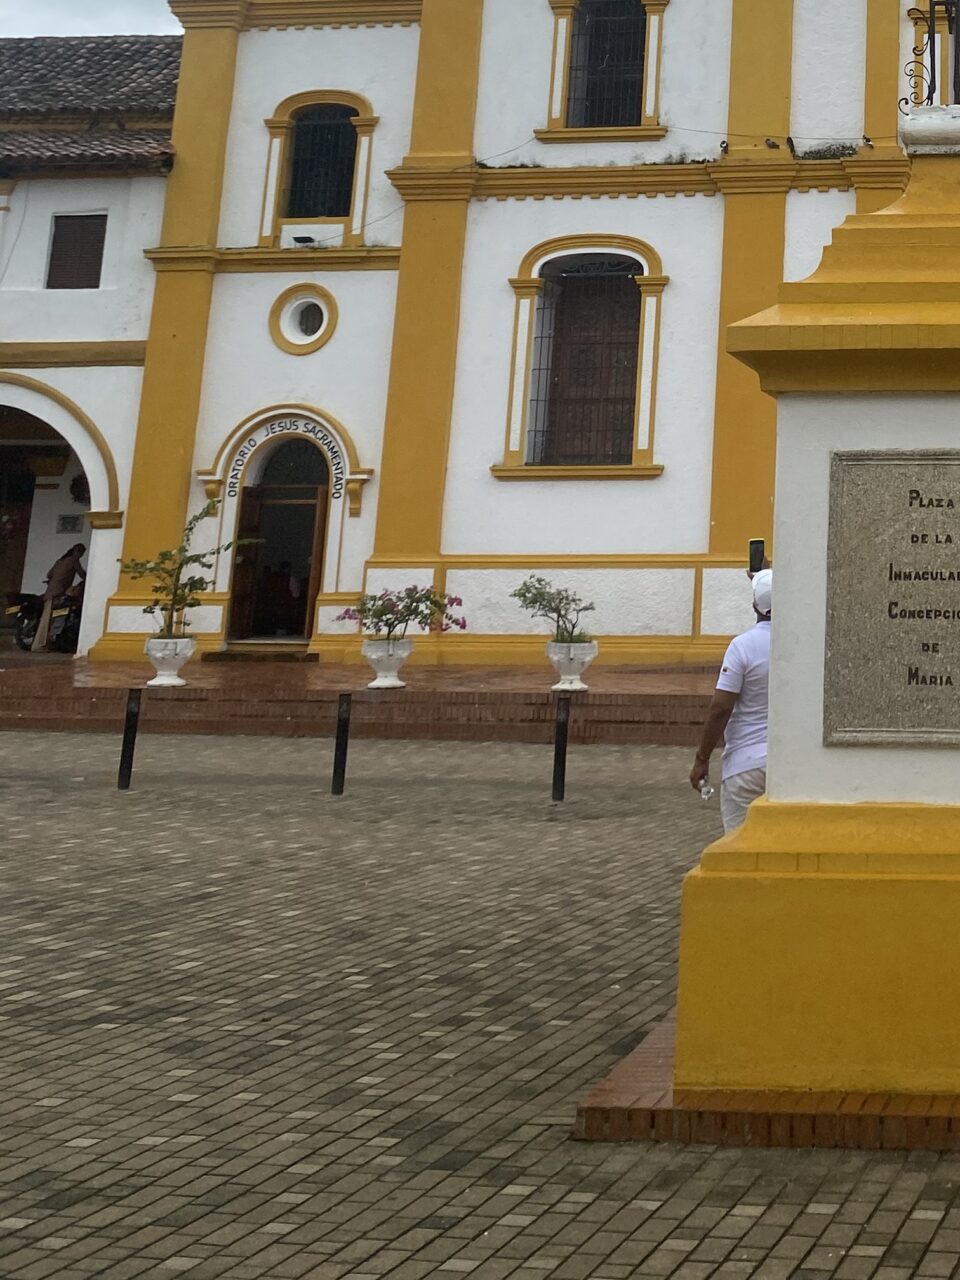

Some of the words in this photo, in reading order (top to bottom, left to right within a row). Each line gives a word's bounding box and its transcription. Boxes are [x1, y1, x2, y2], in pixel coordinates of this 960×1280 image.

[228, 438, 257, 497] ORATORIO
[265, 420, 299, 437] JESUS
[302, 422, 344, 499] SACRAMENTADO
[908, 489, 955, 509] PLAZA
[910, 534, 929, 544] DE
[935, 534, 953, 544] LA
[921, 642, 940, 654] DE
[907, 666, 954, 686] MARIA
